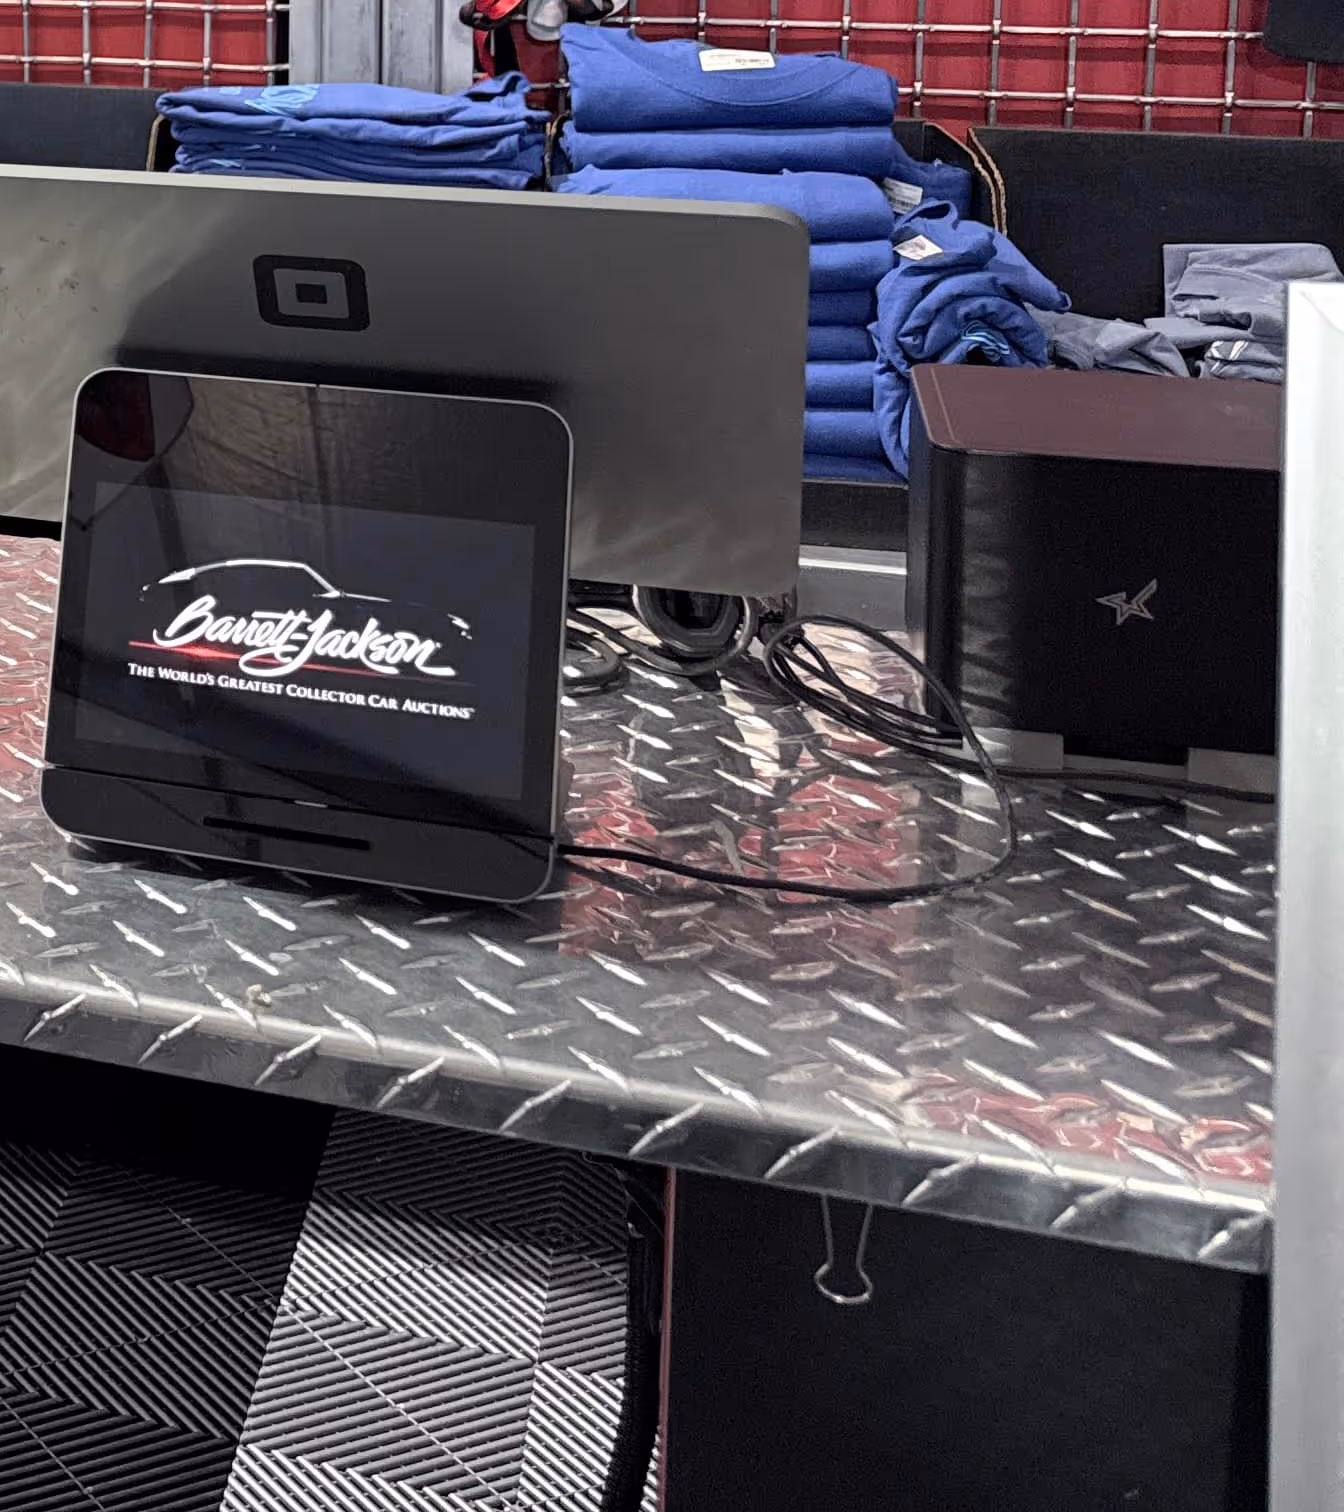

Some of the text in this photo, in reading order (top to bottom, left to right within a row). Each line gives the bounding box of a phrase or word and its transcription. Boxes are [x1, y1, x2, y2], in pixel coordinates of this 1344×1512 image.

[153, 594, 456, 678] Barrett-Jackson
[127, 662, 470, 719] THE WORLD'S GREATEST COLLECTOR CAR AUCTIONS
